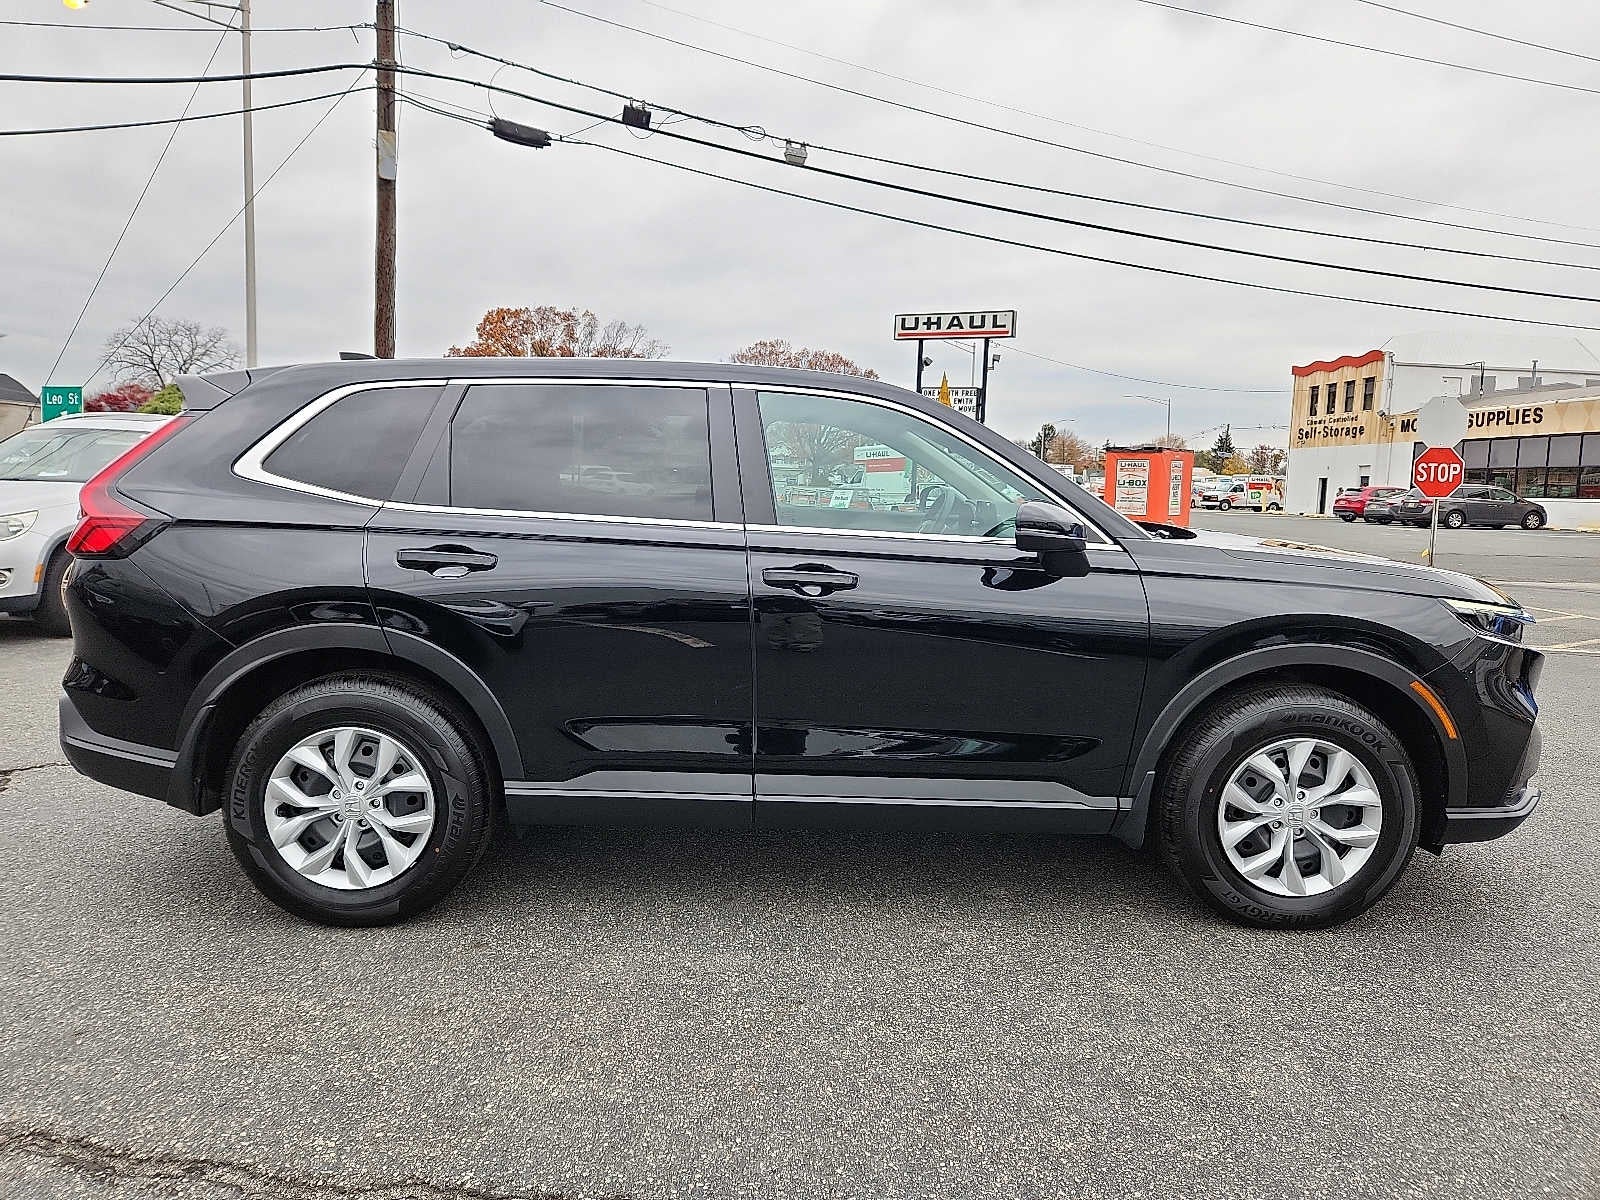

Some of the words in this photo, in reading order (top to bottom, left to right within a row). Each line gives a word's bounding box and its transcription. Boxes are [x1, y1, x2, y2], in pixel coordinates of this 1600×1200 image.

[46, 393, 63, 404] Leo
[68, 392, 79, 404] St
[1468, 407, 1544, 429] SUPPLIES
[1297, 425, 1365, 440] Self-Storage
[1416, 462, 1461, 484] STOP
